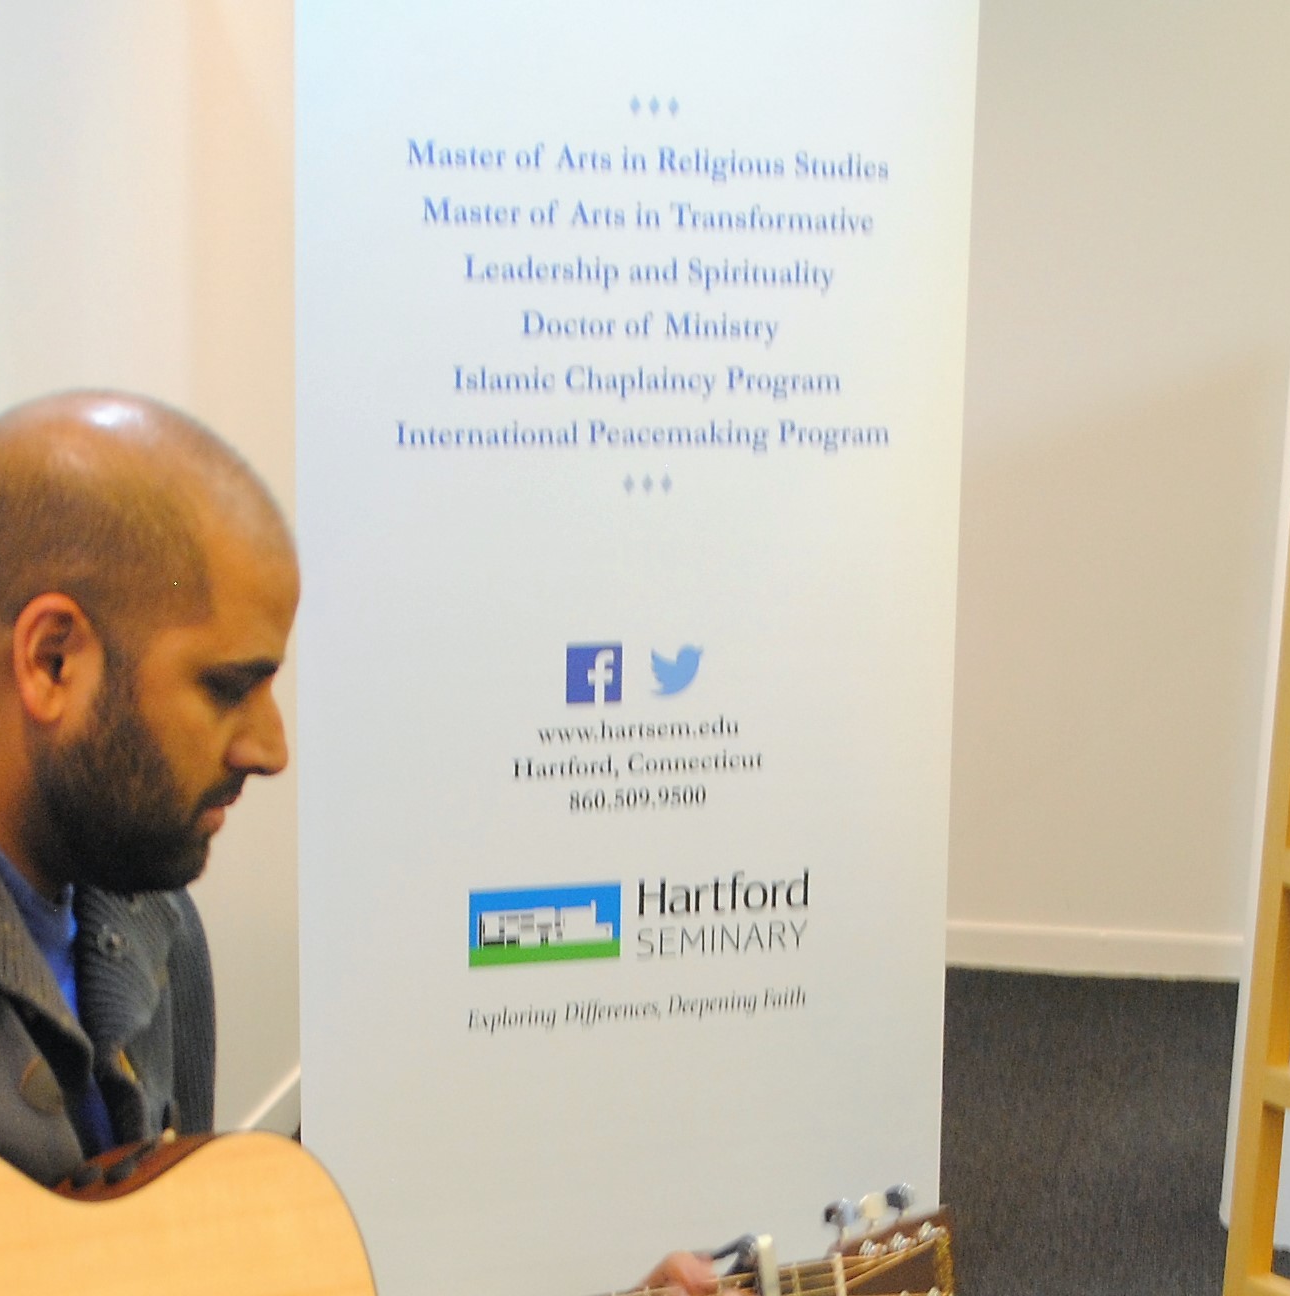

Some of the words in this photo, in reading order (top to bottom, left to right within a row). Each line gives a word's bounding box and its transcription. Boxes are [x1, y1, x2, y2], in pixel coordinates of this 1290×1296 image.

[407, 138, 506, 169] Master
[515, 143, 545, 169] of
[557, 144, 611, 172] Arts
[622, 146, 646, 172] in
[658, 147, 784, 182] Religious
[794, 151, 889, 180] Studies
[422, 197, 520, 226] Master
[529, 200, 558, 226] of
[570, 201, 625, 228] Arts
[636, 202, 660, 228] in
[671, 202, 873, 234] Transformative
[463, 253, 618, 290] Leadership
[628, 257, 679, 284] and
[688, 258, 834, 295] Spirituality
[522, 310, 616, 338] Doctor
[624, 312, 653, 338] of
[664, 312, 779, 347] Ministry
[453, 365, 556, 393] Islamic
[565, 366, 716, 400] Chaplaincy
[727, 366, 841, 400] Program
[395, 420, 578, 448] International
[588, 419, 769, 452] Peacemaking
[779, 419, 889, 452] Program
[537, 716, 740, 746] www.hartsem.edu
[512, 755, 619, 781] Hartford,
[628, 750, 764, 775] Connecticut
[569, 786, 707, 812] 860.509.9500
[637, 868, 809, 917] Hartford
[637, 920, 808, 960] SEMINARY
[467, 1006, 557, 1035] Exploring
[564, 999, 660, 1027] Differences,
[668, 991, 758, 1020] Deepening
[763, 985, 807, 1010] Faith
